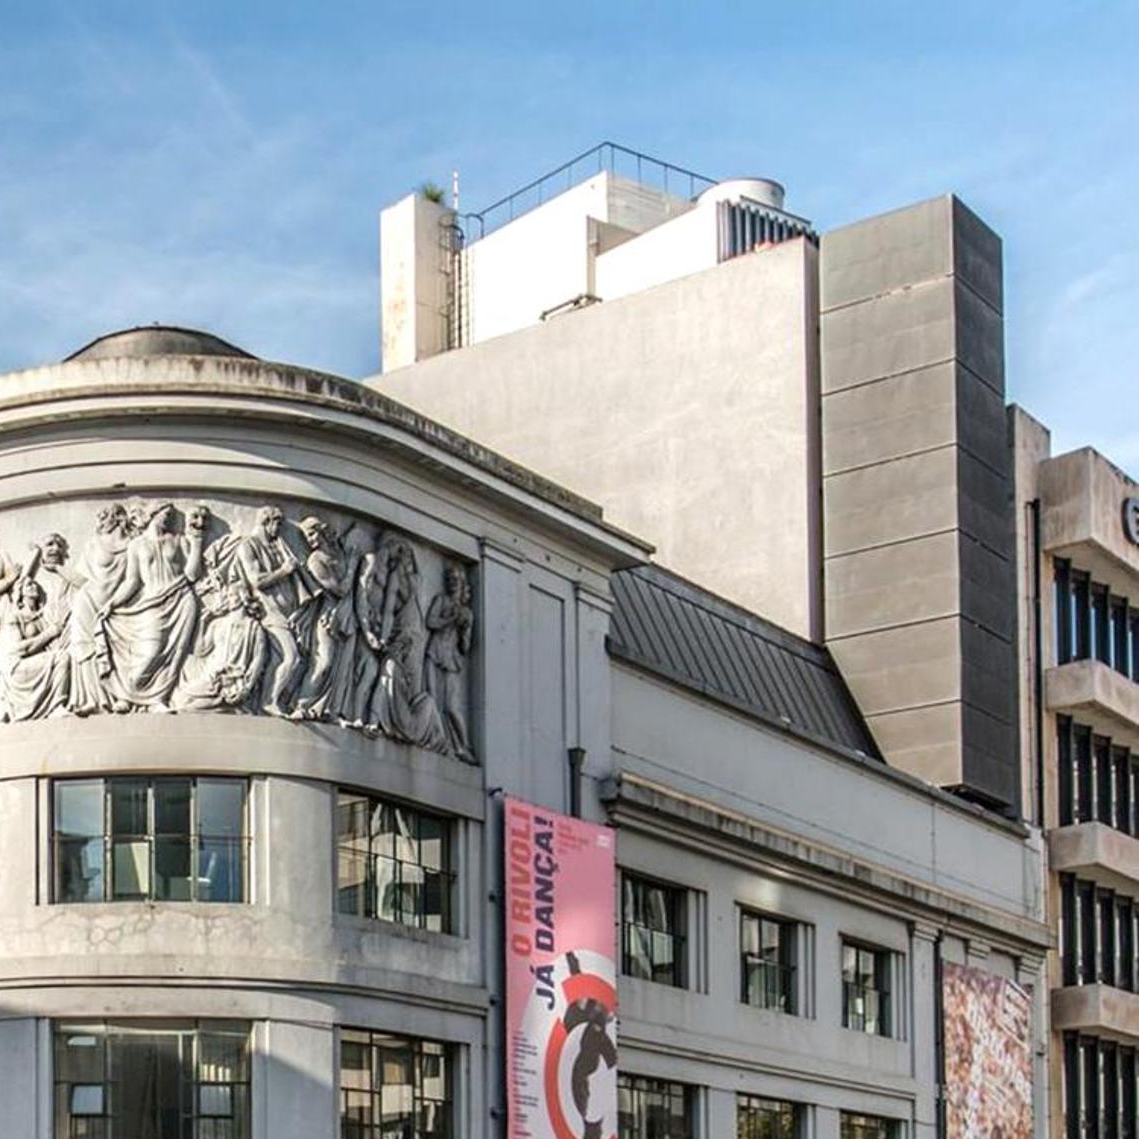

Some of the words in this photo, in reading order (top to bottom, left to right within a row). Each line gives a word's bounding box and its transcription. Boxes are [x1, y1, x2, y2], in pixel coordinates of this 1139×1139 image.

[510, 807, 532, 923] RIVOLI
[534, 816, 559, 953] DANÇA!
[512, 935, 532, 957] O
[530, 964, 556, 1010] JÁ
